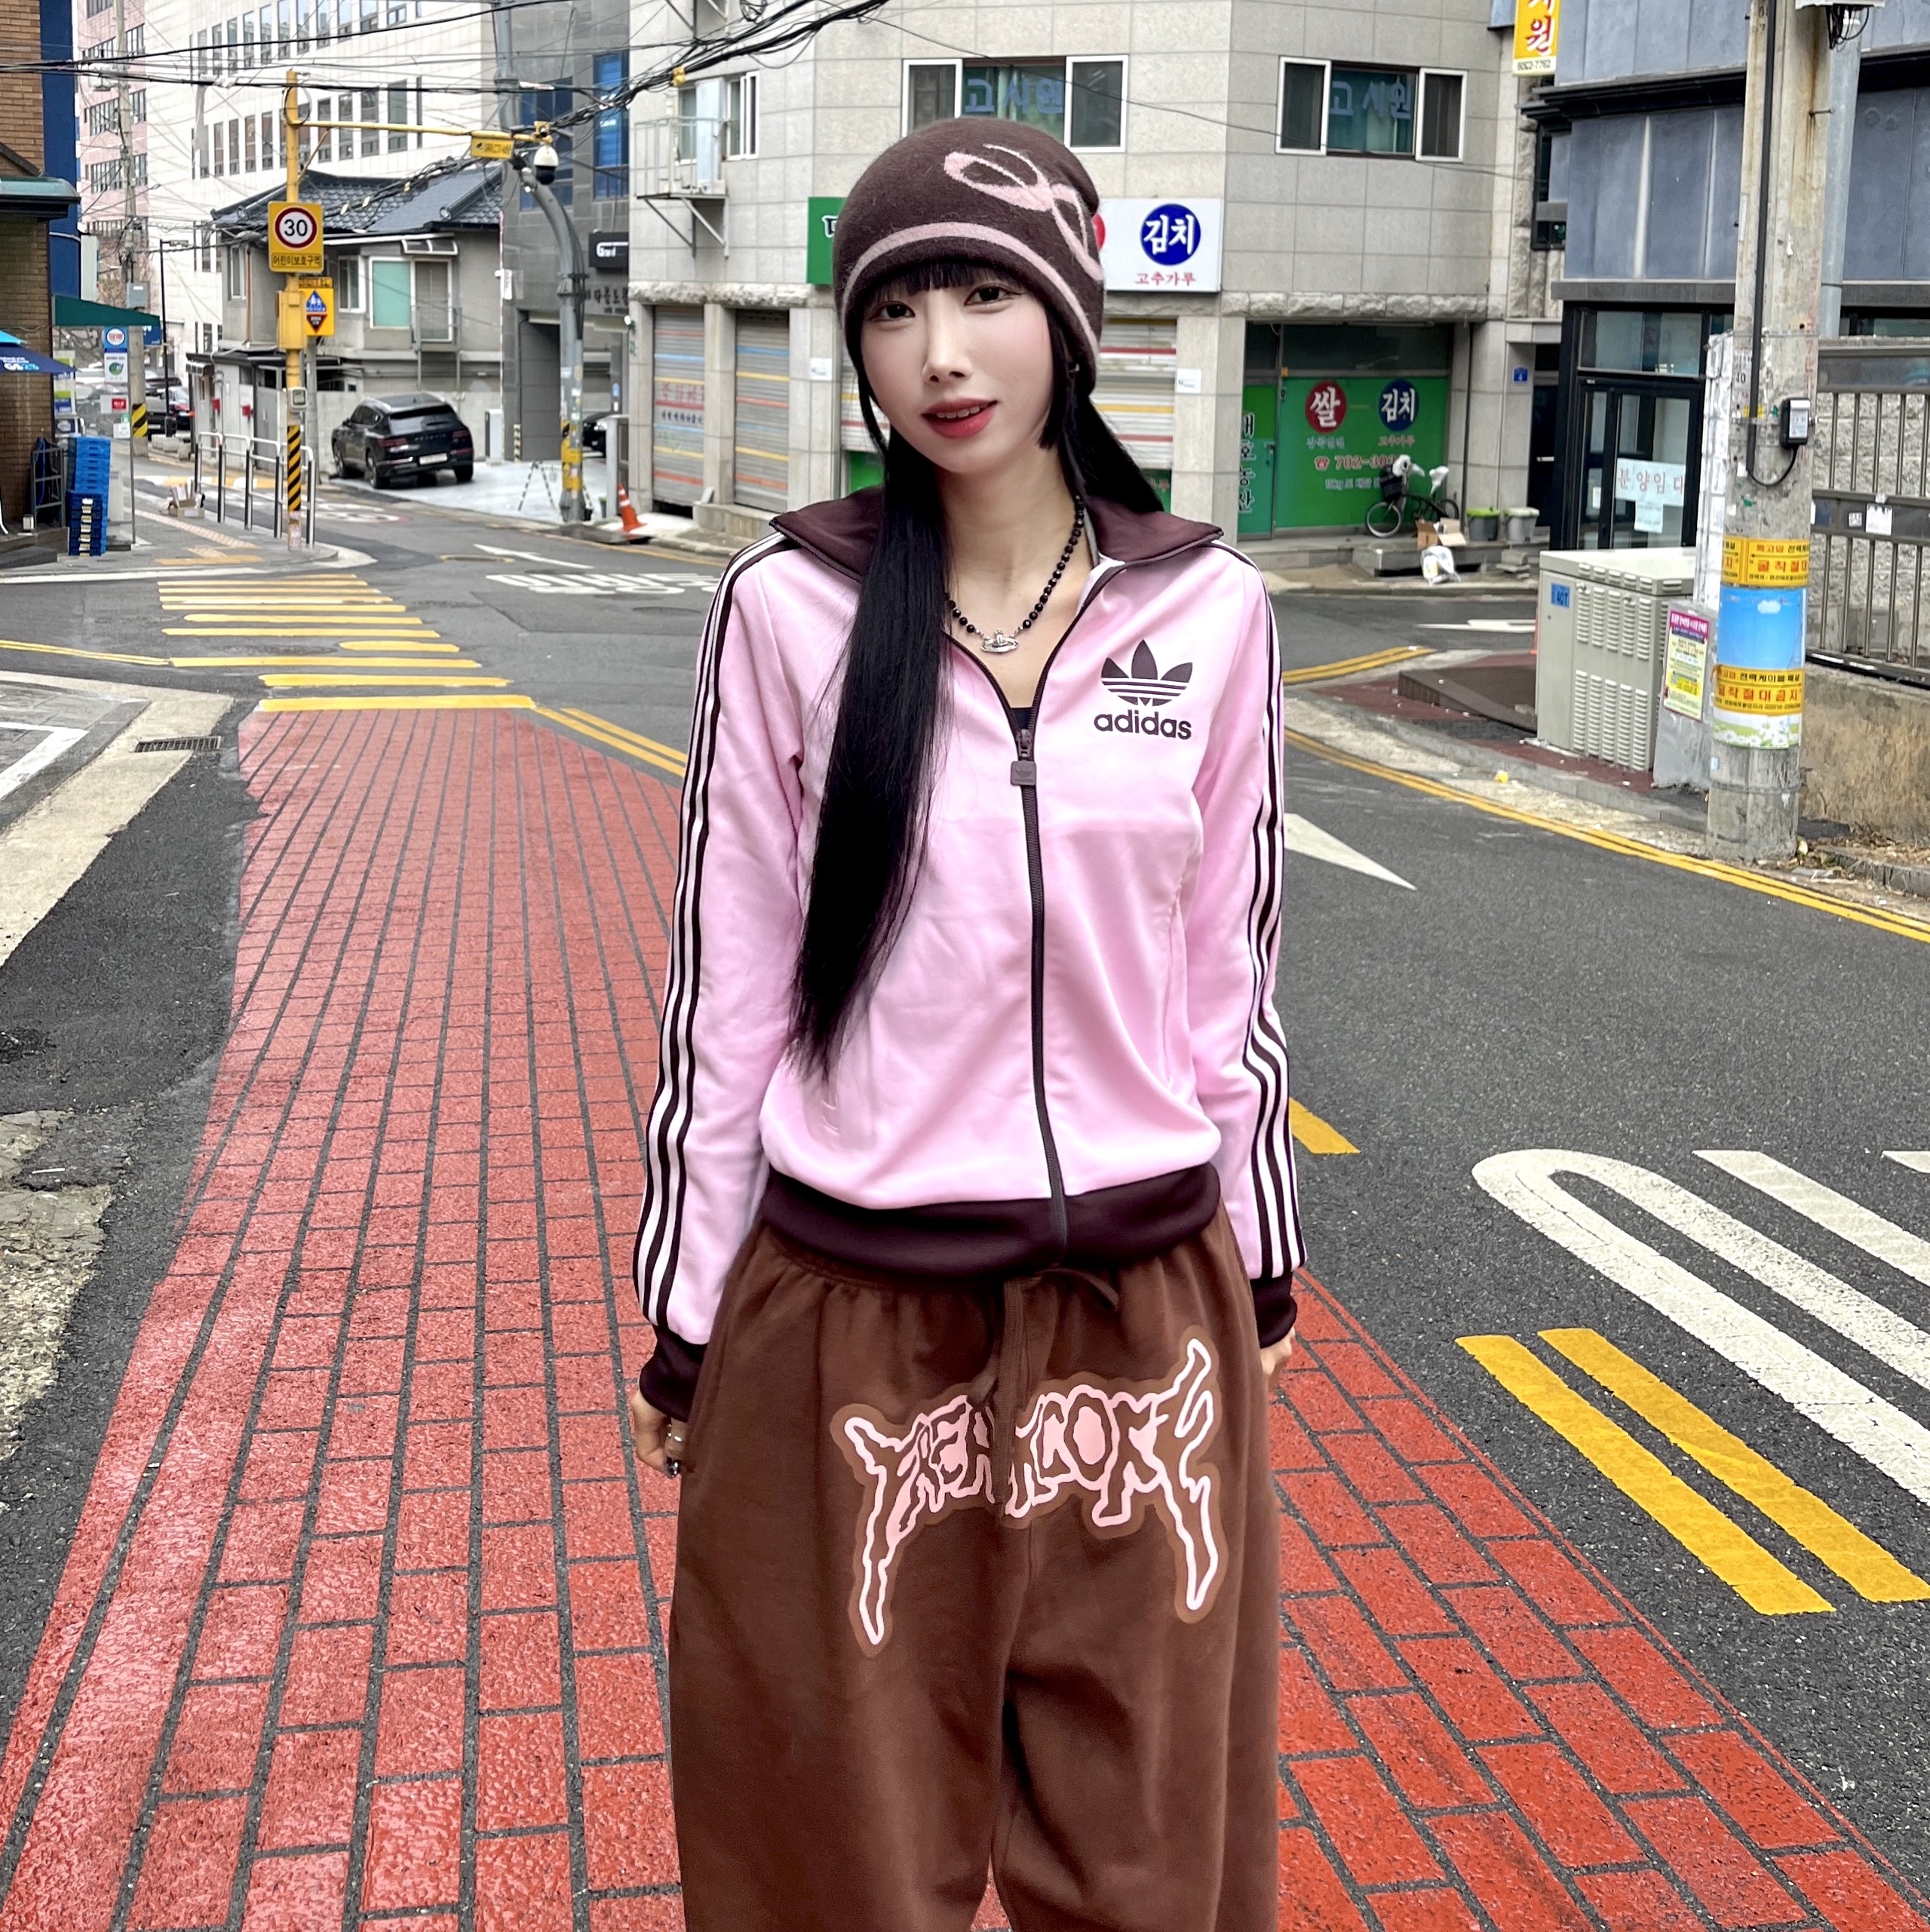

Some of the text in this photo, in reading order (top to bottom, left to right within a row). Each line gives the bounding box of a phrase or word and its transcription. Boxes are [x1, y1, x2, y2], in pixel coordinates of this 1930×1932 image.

[965, 78, 1064, 113] 고시원
[1329, 80, 1412, 120] 고시원
[284, 219, 308, 236] 30
[1143, 214, 1194, 255] 김치
[273, 255, 322, 266] 어린이보호구역
[1134, 272, 1195, 287] 고추가루
[1309, 385, 1341, 428] 쌀
[1381, 388, 1416, 422] 김치
[1094, 708, 1192, 740] adidas
